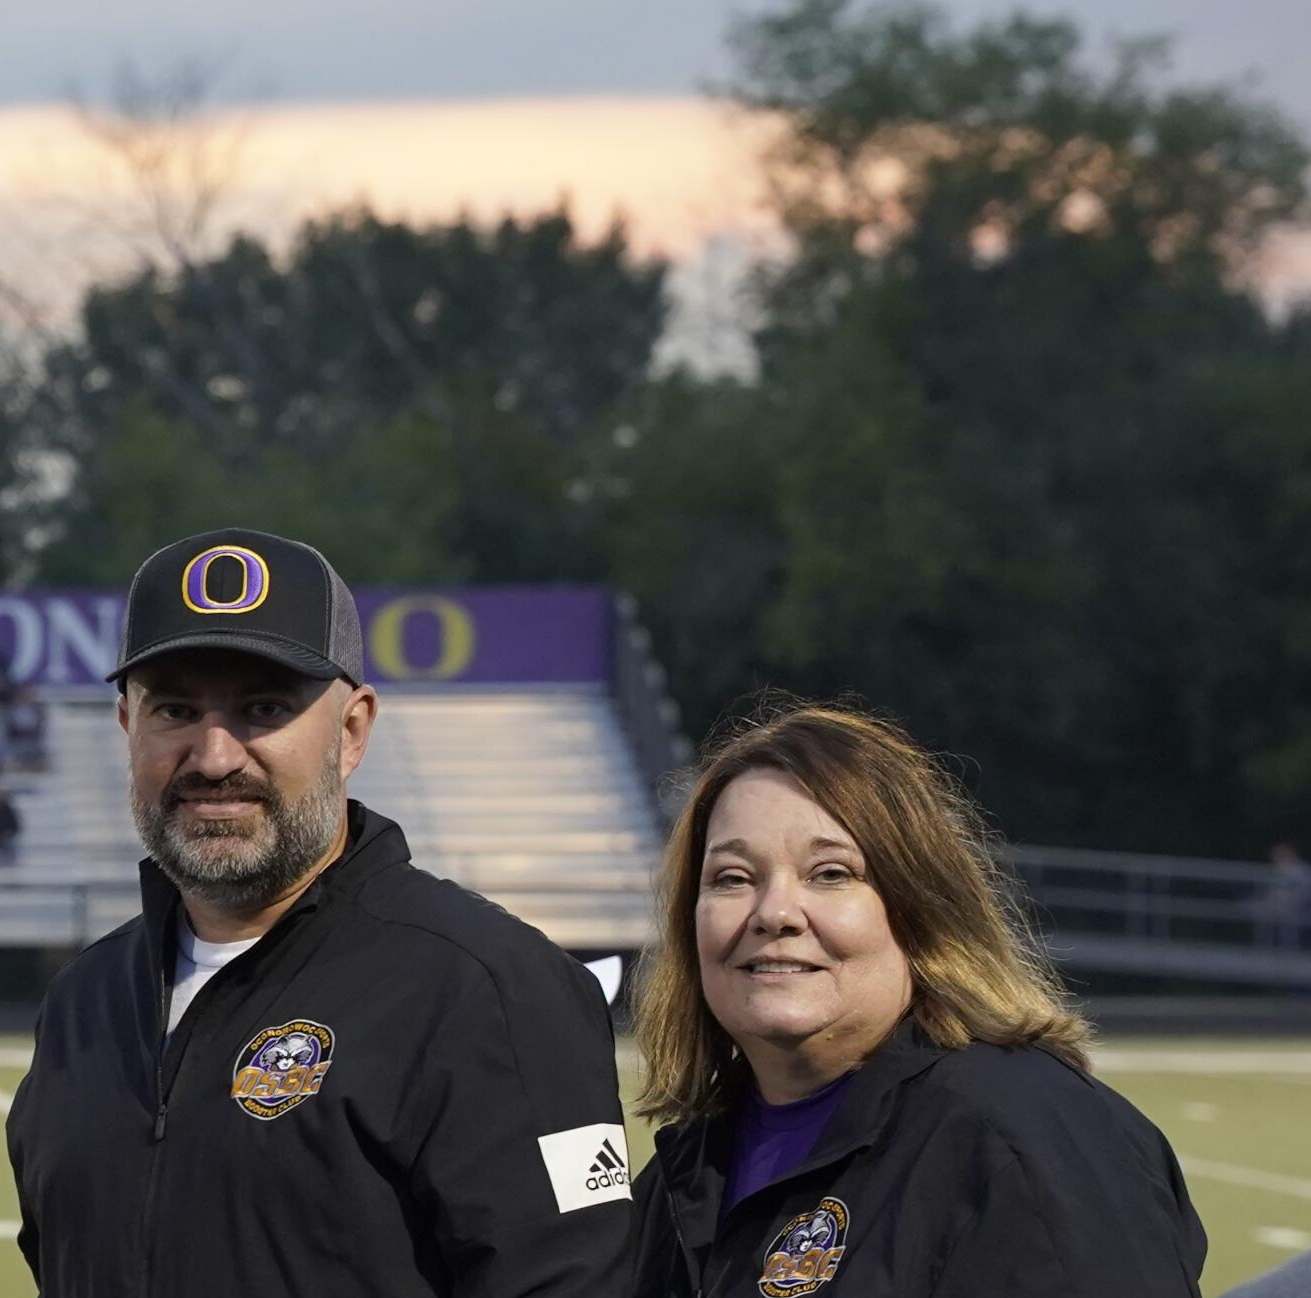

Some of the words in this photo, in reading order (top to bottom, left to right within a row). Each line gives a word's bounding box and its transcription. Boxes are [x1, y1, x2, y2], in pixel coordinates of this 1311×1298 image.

[182, 545, 270, 614] O
[369, 593, 475, 684] O
[230, 1060, 333, 1099] OSBC
[585, 1169, 631, 1191] adid
